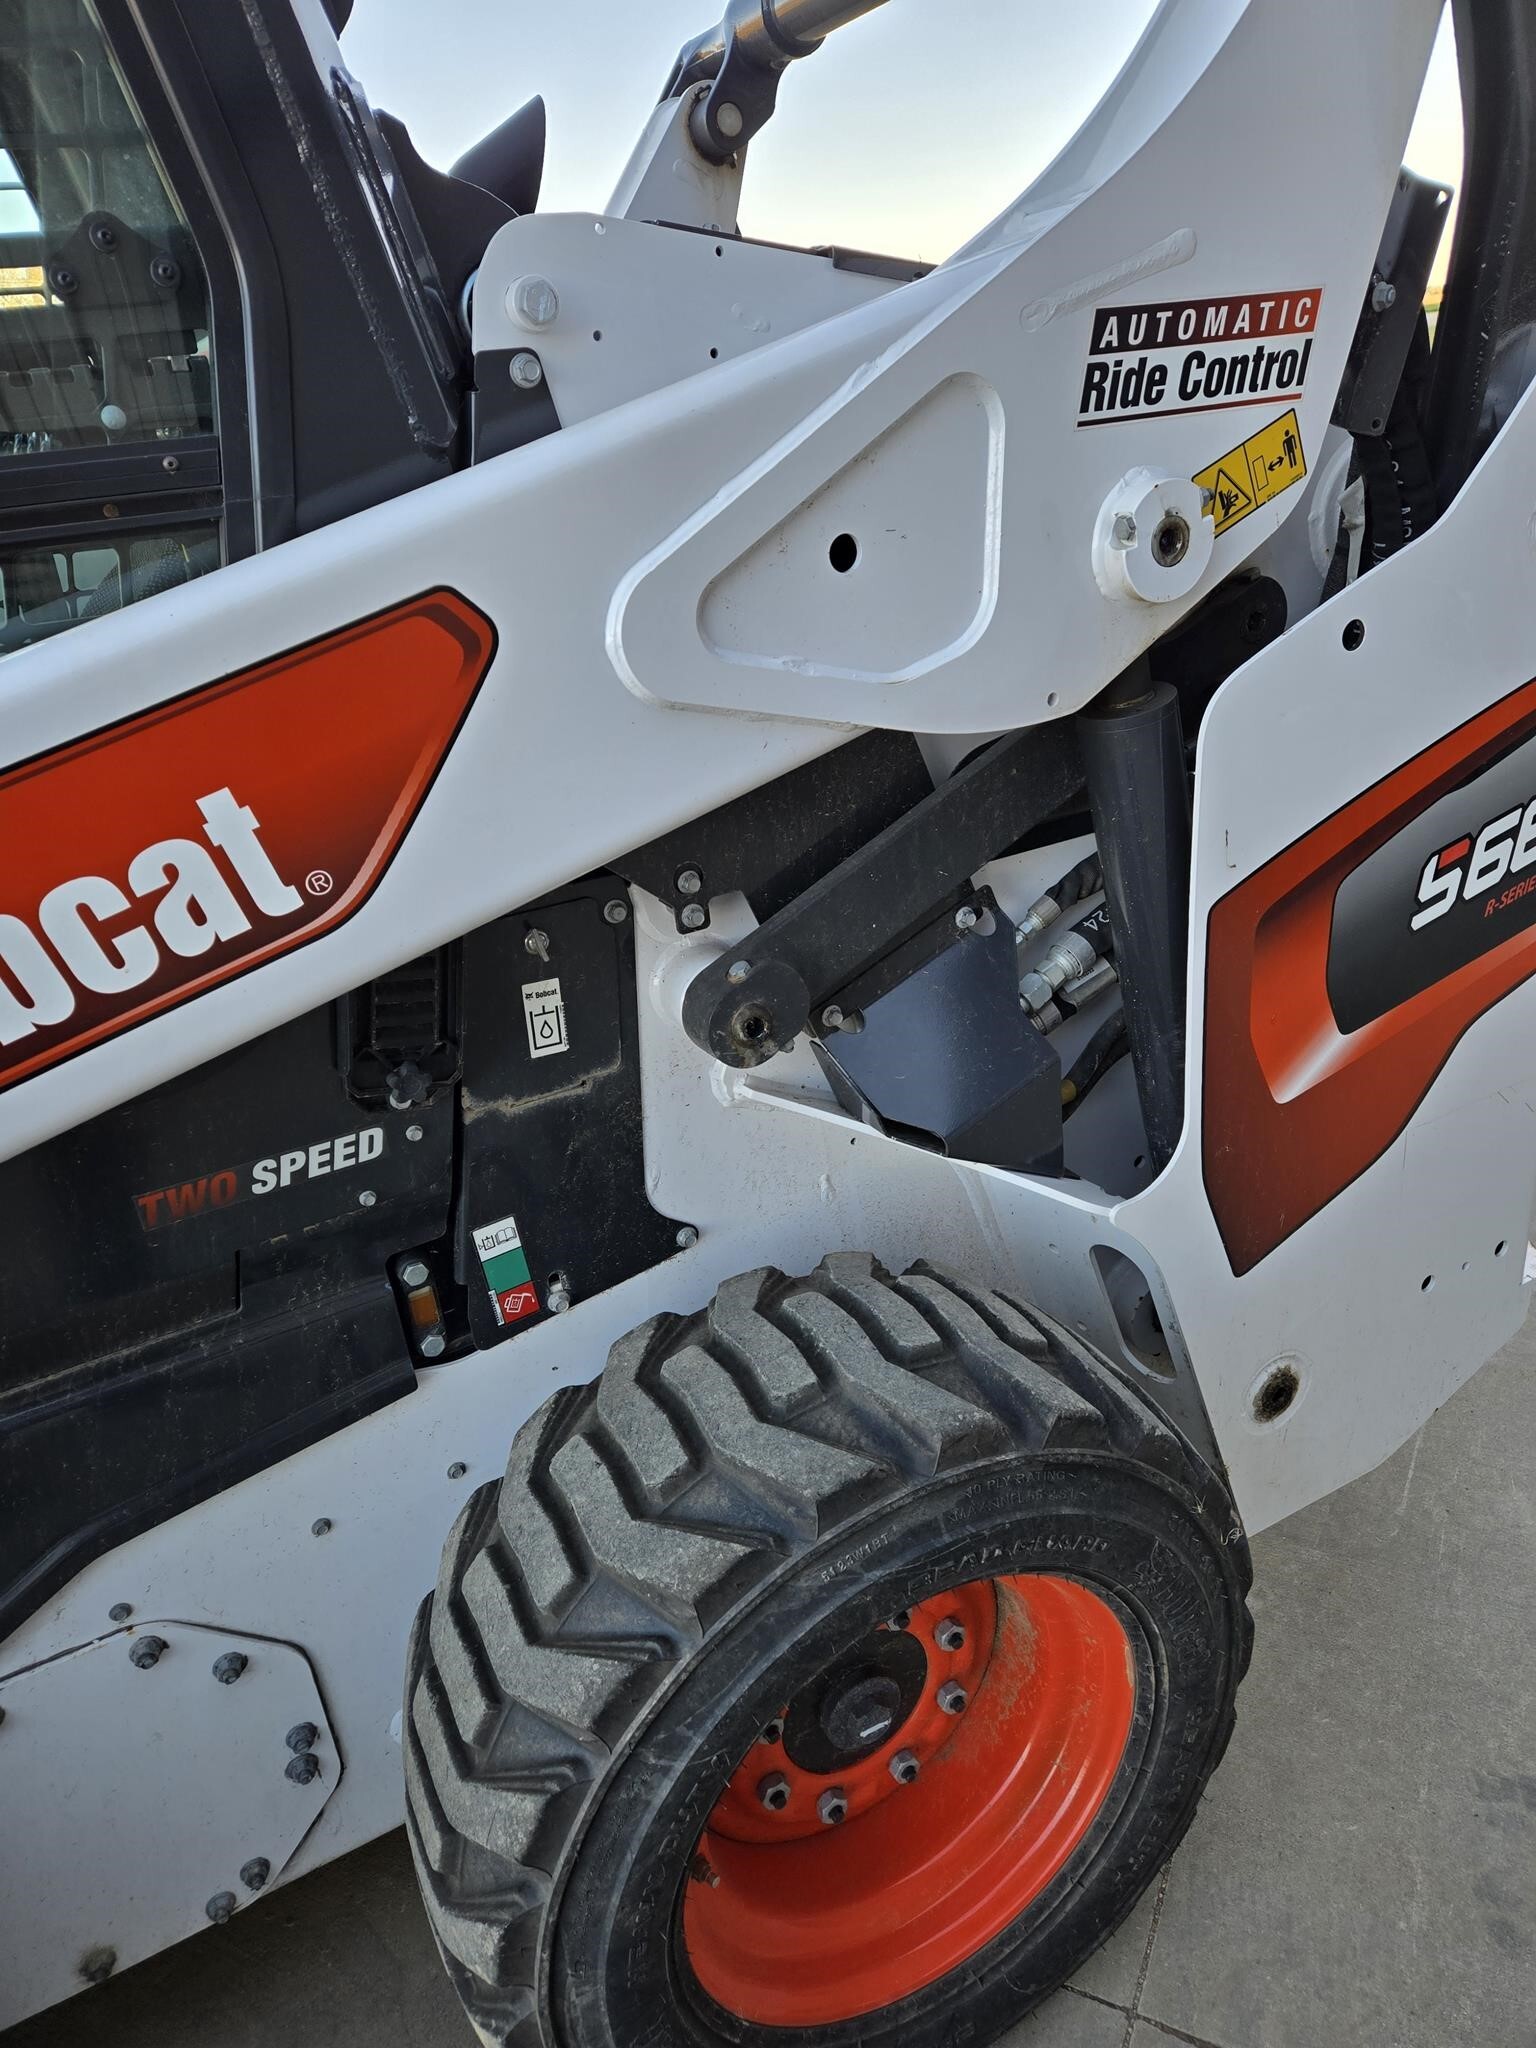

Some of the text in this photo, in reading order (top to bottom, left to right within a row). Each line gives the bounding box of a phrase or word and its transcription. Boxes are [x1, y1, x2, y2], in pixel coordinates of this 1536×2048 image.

[1099, 297, 1312, 348] AUTOMATIC
[1079, 338, 1313, 414] Ride Control
[1484, 876, 1536, 918] R-SERIE
[1082, 909, 1110, 931] 24
[535, 988, 558, 999] Bobcat
[137, 1127, 384, 1227] TWO SPEED
[987, 1475, 1010, 1490] PLY
